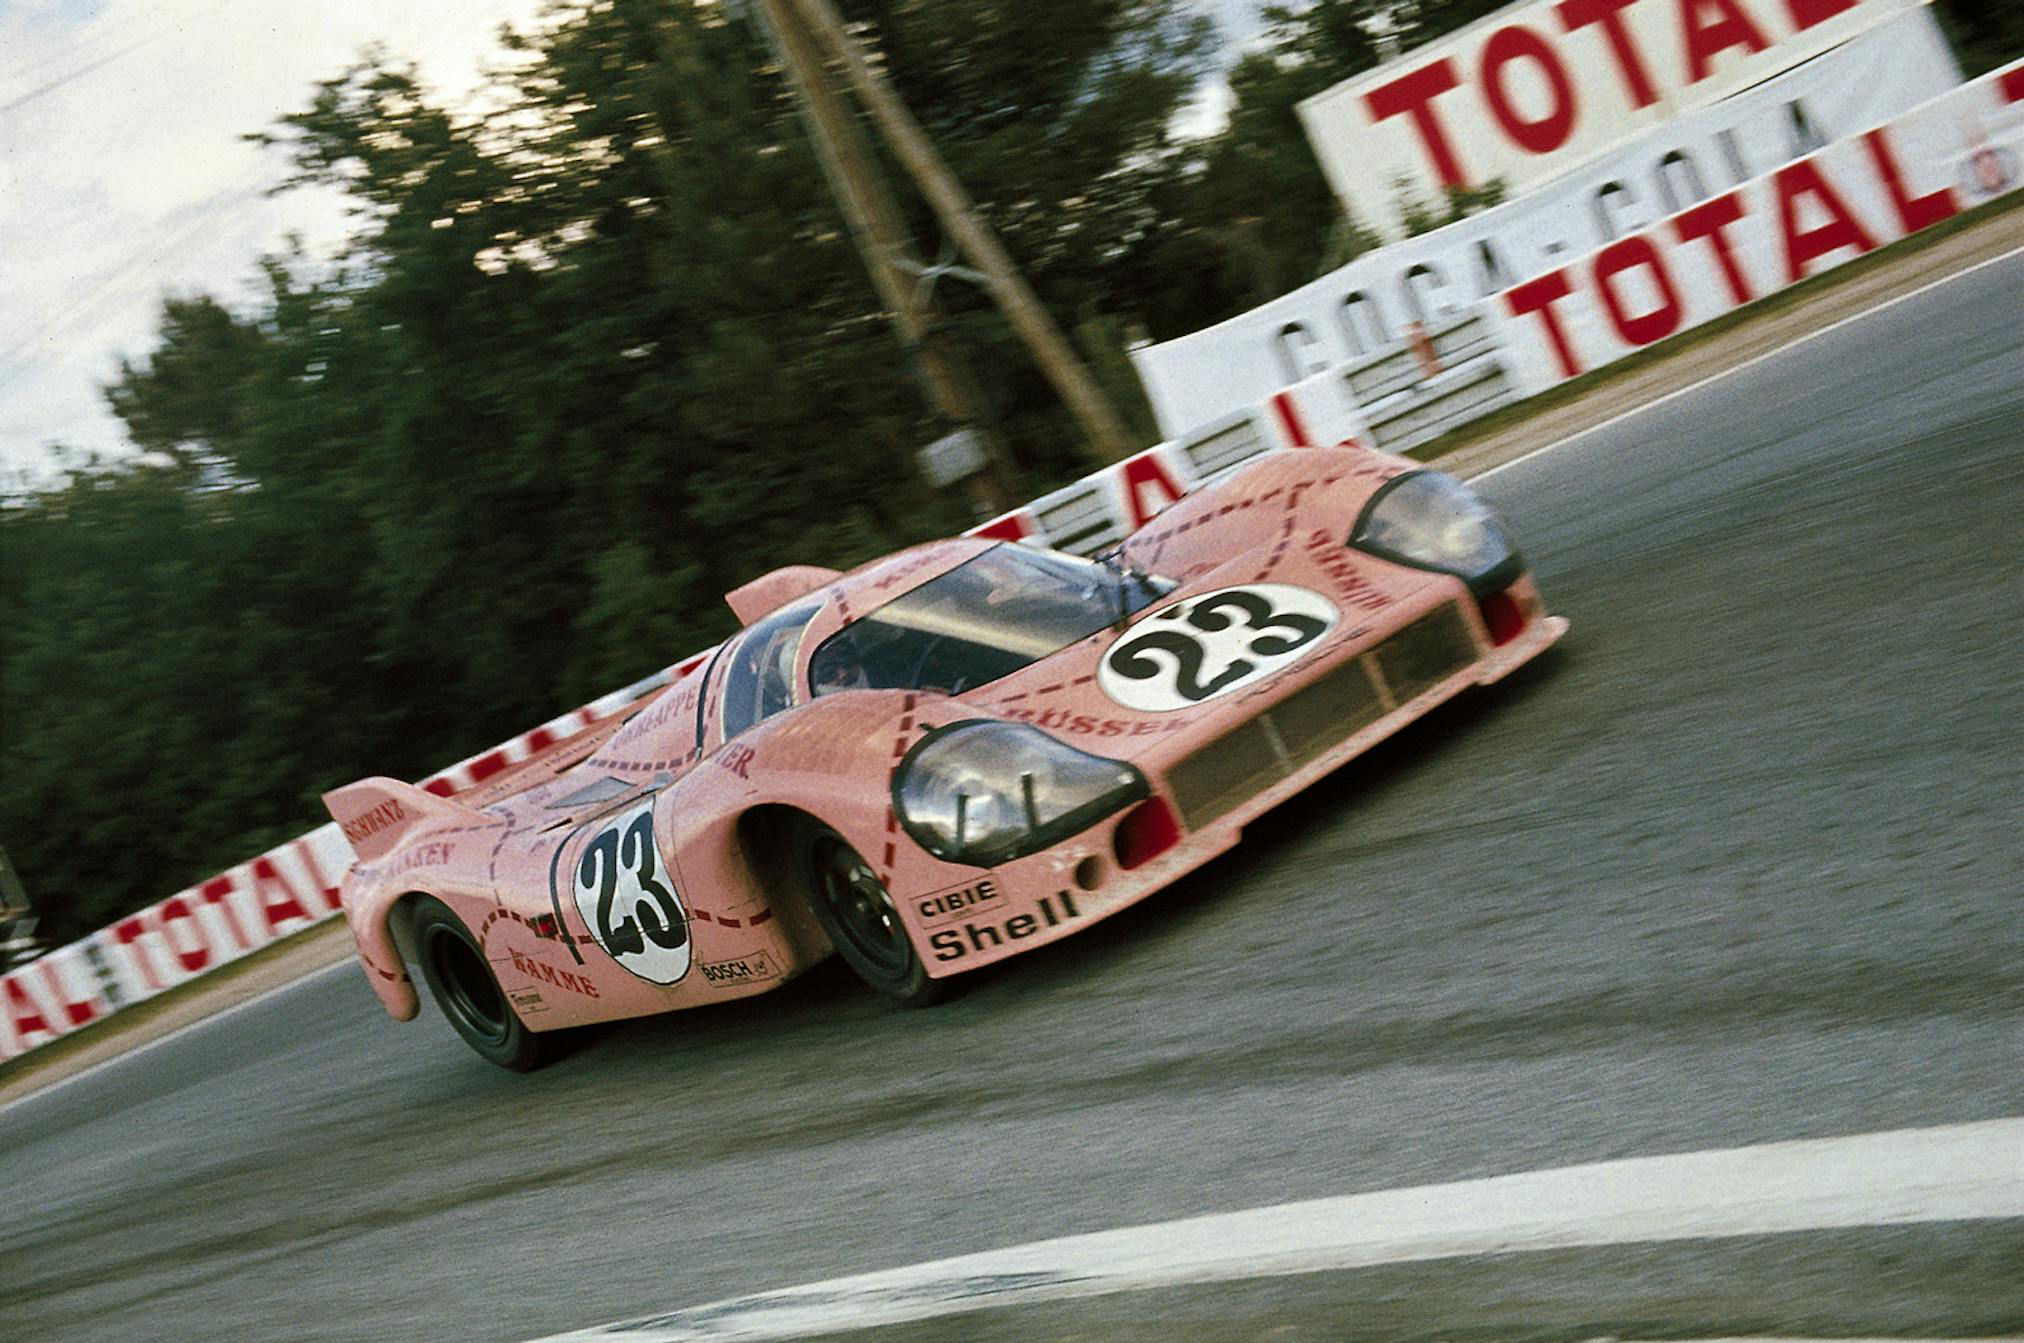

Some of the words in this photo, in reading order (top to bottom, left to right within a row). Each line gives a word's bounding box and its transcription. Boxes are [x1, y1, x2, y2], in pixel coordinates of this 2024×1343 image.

[1503, 130, 1960, 378] TOTAL
[1108, 591, 1328, 701] 23
[112, 838, 344, 990] TOTAL
[580, 811, 688, 958] 23
[929, 889, 1080, 962] Shell
[701, 961, 753, 981] BOSCH
